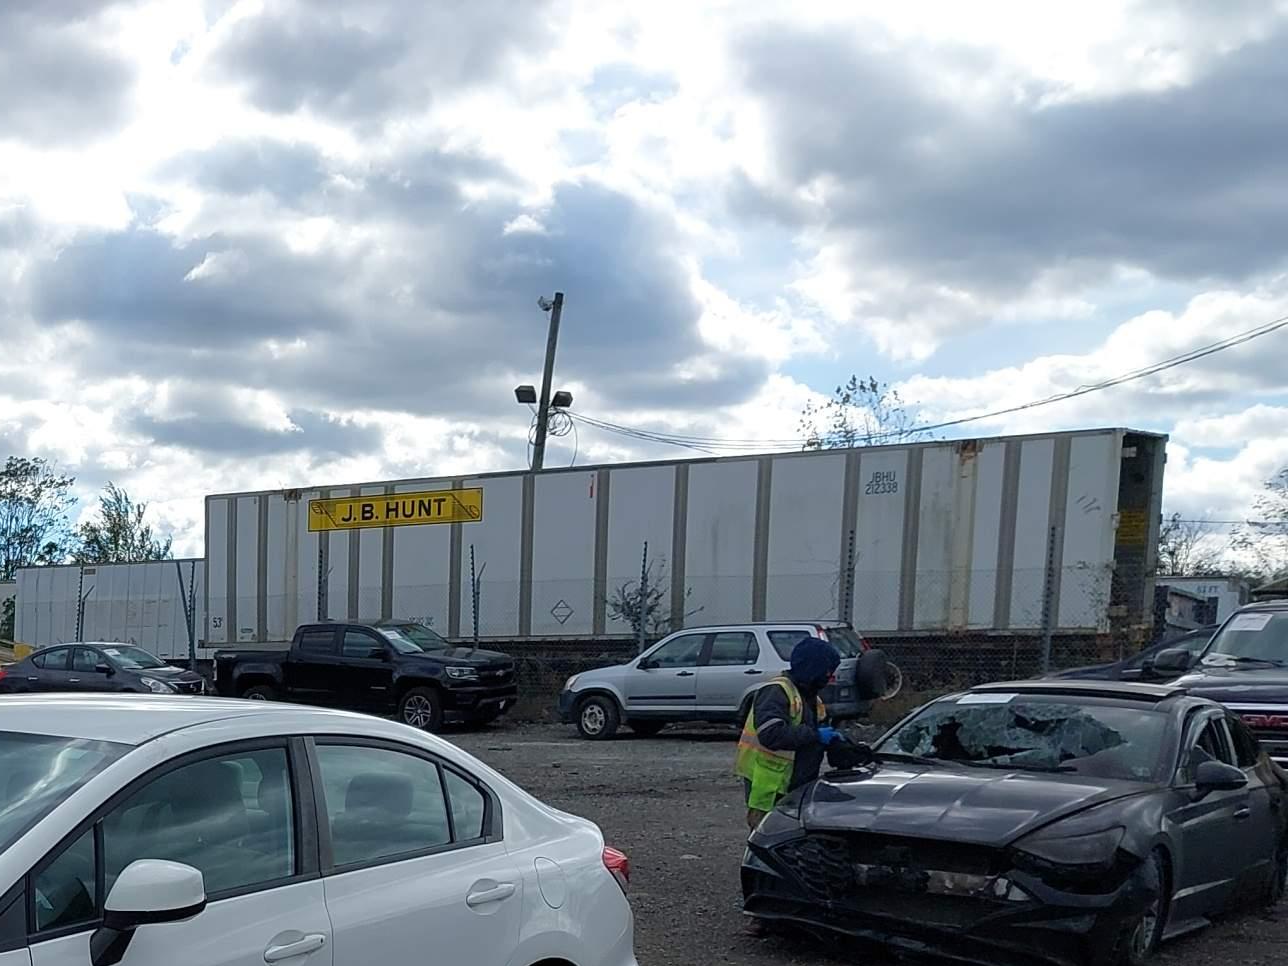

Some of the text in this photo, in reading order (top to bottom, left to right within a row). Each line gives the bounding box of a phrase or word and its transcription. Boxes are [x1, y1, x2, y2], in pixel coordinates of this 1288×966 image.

[869, 471, 896, 484] JBHU
[865, 482, 898, 495] 212338
[341, 498, 447, 523] J. B. HUNT
